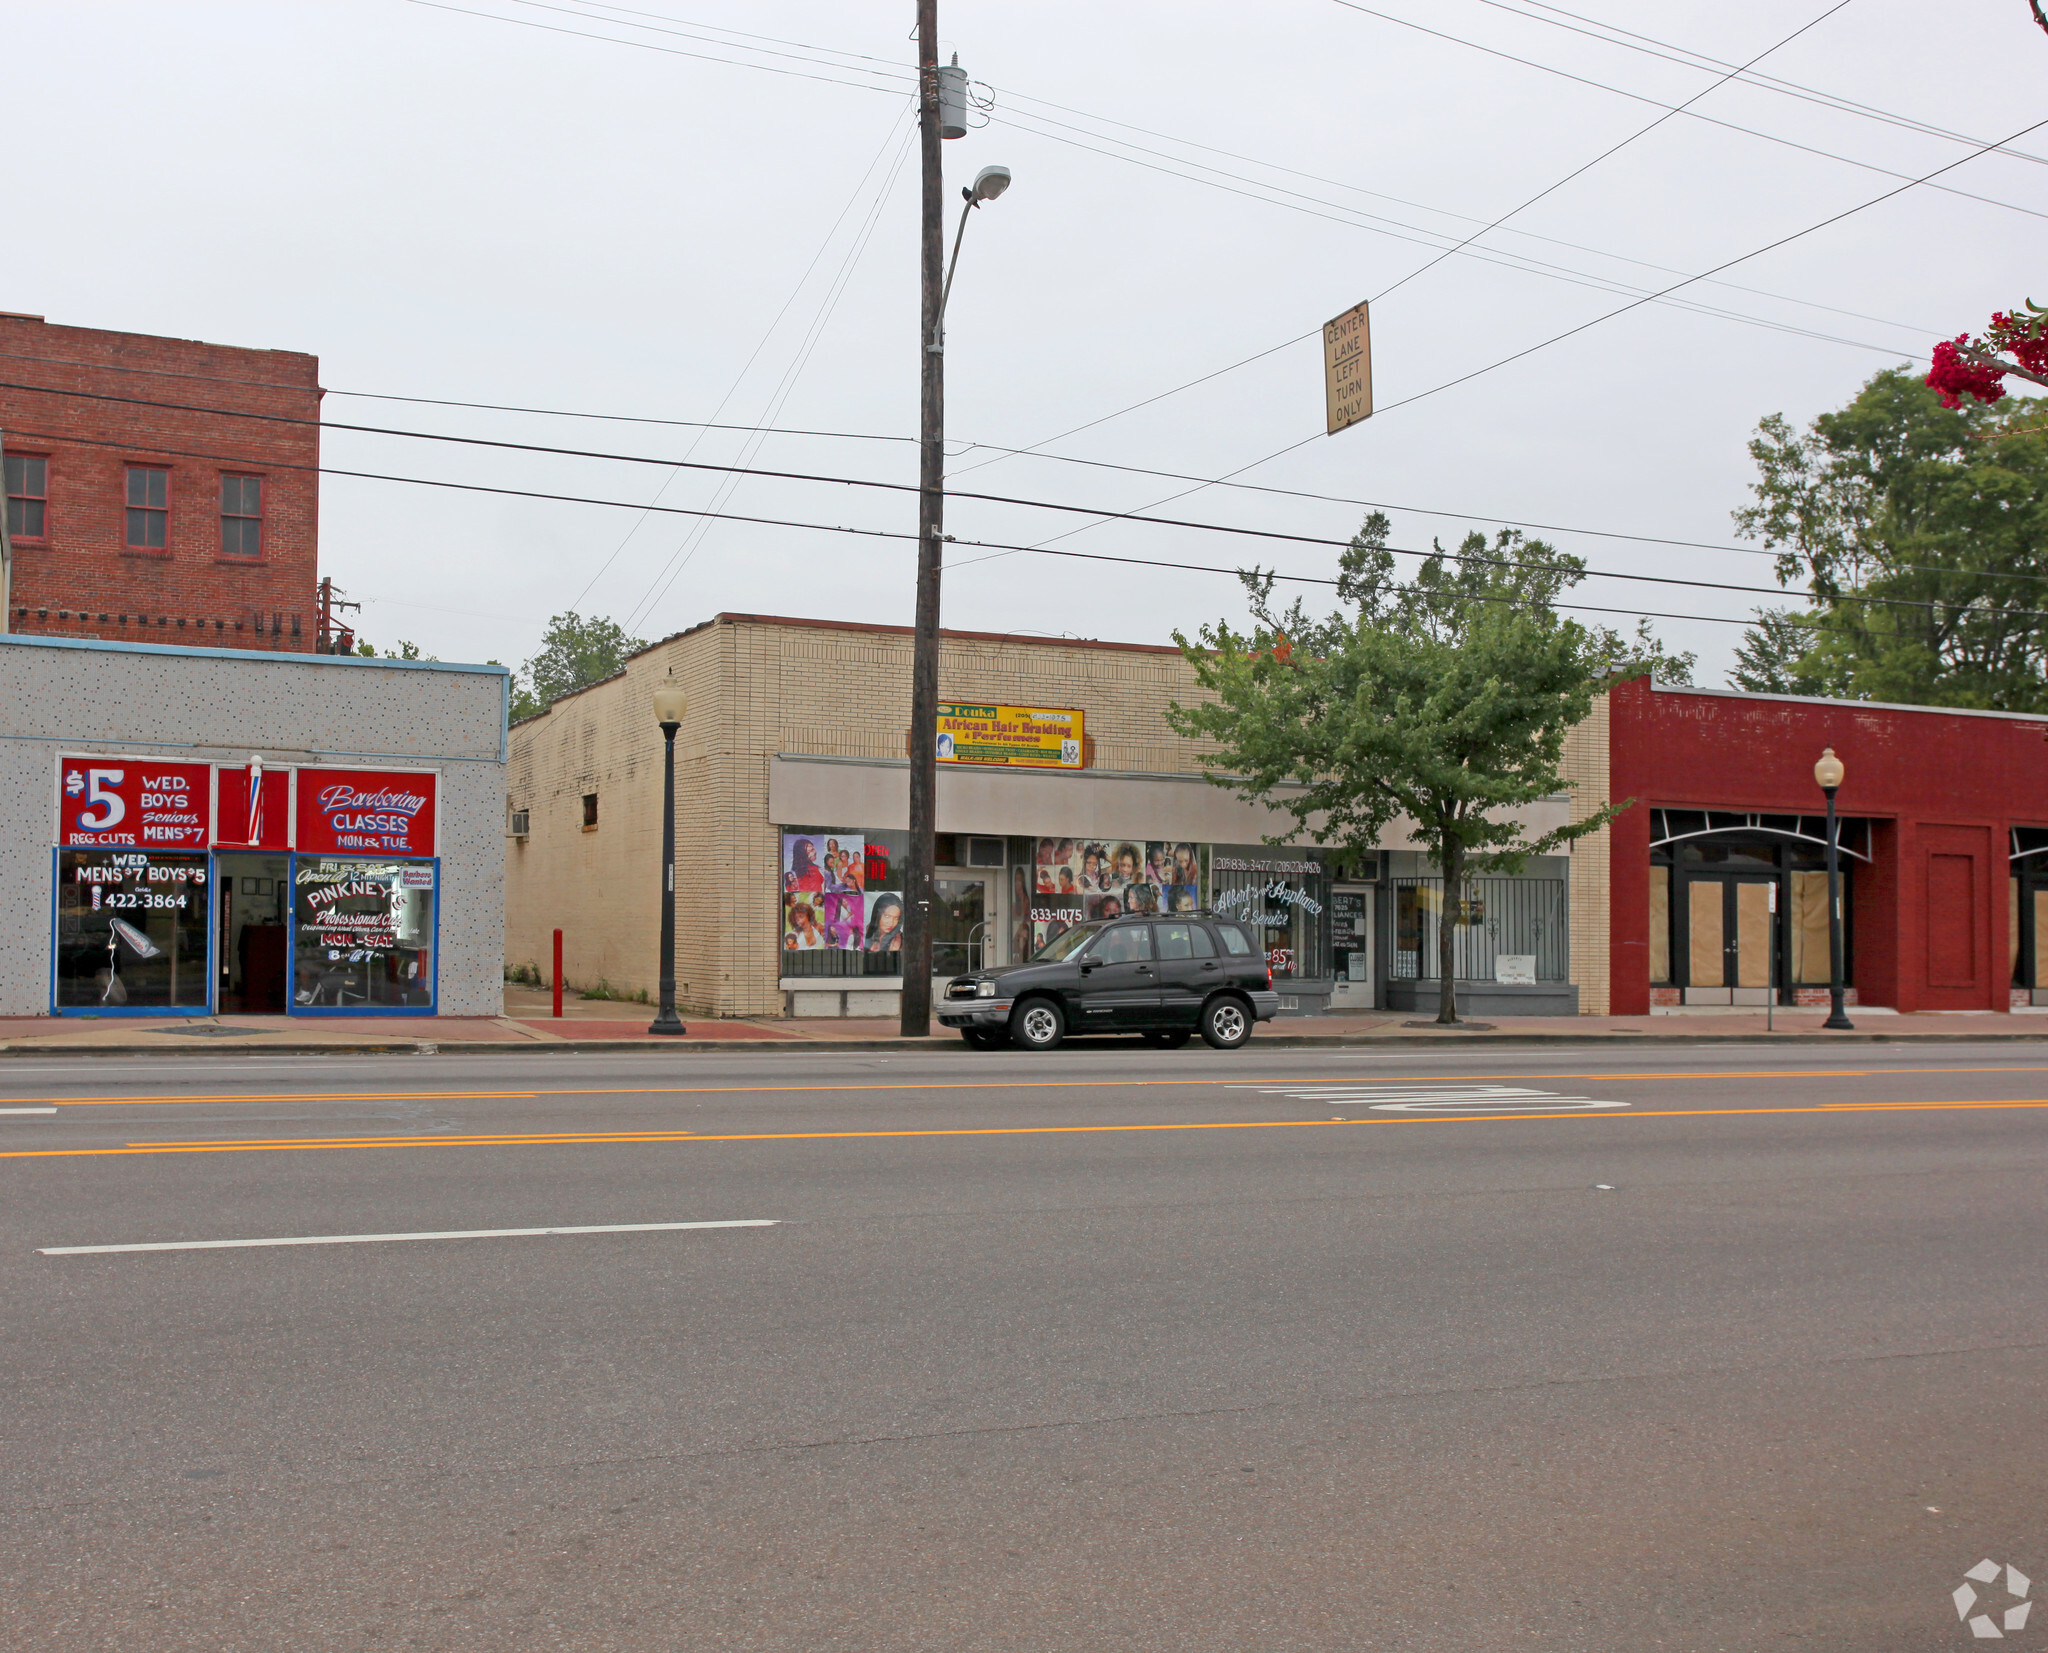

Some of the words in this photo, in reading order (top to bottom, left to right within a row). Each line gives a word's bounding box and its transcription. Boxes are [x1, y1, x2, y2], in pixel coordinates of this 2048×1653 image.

[1328, 312, 1365, 344] CENTER
[1334, 335, 1360, 361] LANE
[1336, 358, 1360, 383] LEFT
[1336, 377, 1362, 402] TURN
[1336, 397, 1362, 422] ONLY
[955, 707, 995, 718] Douka
[943, 718, 988, 730] African
[992, 720, 1019, 732] Hair
[1022, 722, 1072, 738] Braiding
[972, 731, 1041, 742] Perfumes
[142, 776, 190, 790] WED.
[141, 793, 188, 808] BOYS
[319, 785, 427, 816] Barbering
[142, 811, 199, 825] Seniors
[332, 814, 408, 834] CLASSES
[69, 833, 98, 845] REG.
[98, 833, 136, 845] CUTS
[365, 838, 380, 848] &
[381, 836, 412, 849] TUE.
[864, 844, 889, 856] OPEN
[112, 854, 150, 866] WED.
[77, 867, 123, 882] MENS
[148, 867, 187, 881] BOYS
[340, 864, 355, 872] &
[403, 870, 432, 878] Barbers
[296, 869, 332, 885] Open
[350, 872, 360, 881] 12
[105, 893, 187, 908] 422-3864
[1213, 884, 1258, 913] Albert's
[1268, 880, 1322, 918] Appliance
[316, 910, 382, 926] Professional
[1030, 908, 1082, 922] 833-1075
[1251, 909, 1289, 926] Service
[328, 949, 341, 961] 8
[364, 950, 375, 962] 7
